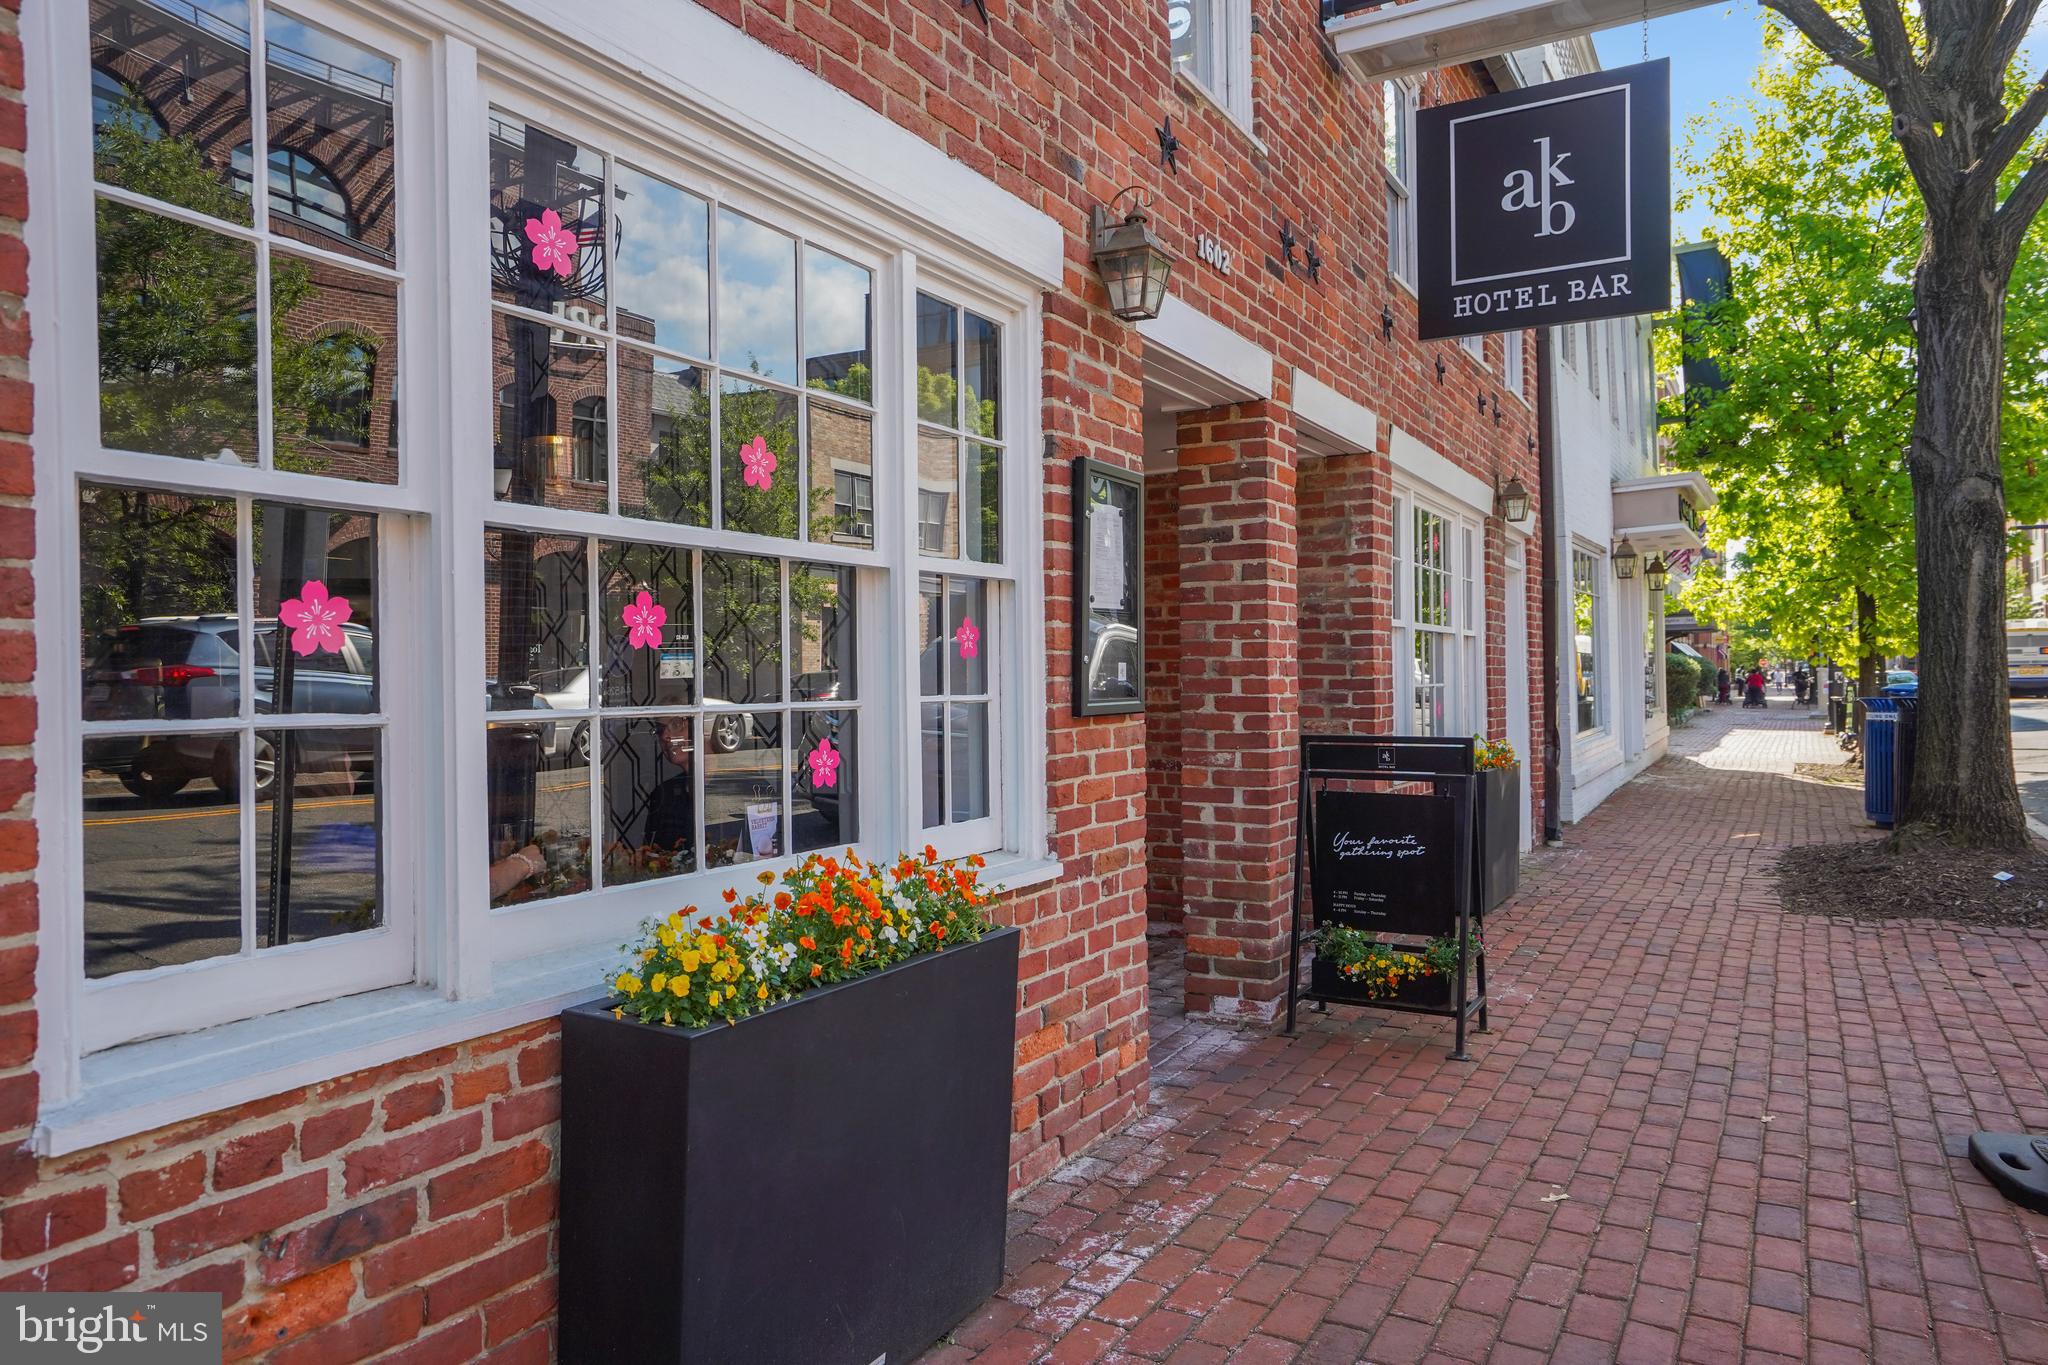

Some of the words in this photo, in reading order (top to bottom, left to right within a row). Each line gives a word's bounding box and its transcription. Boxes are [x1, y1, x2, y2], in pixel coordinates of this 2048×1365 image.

[1197, 233, 1231, 276] 1602
[1453, 284, 1557, 318] HOTEL
[1567, 273, 1632, 303] BAR
[1333, 831, 1364, 852] Your
[1366, 834, 1418, 849] favorite
[1339, 846, 1393, 860] gathering
[1396, 846, 1426, 859] spot
